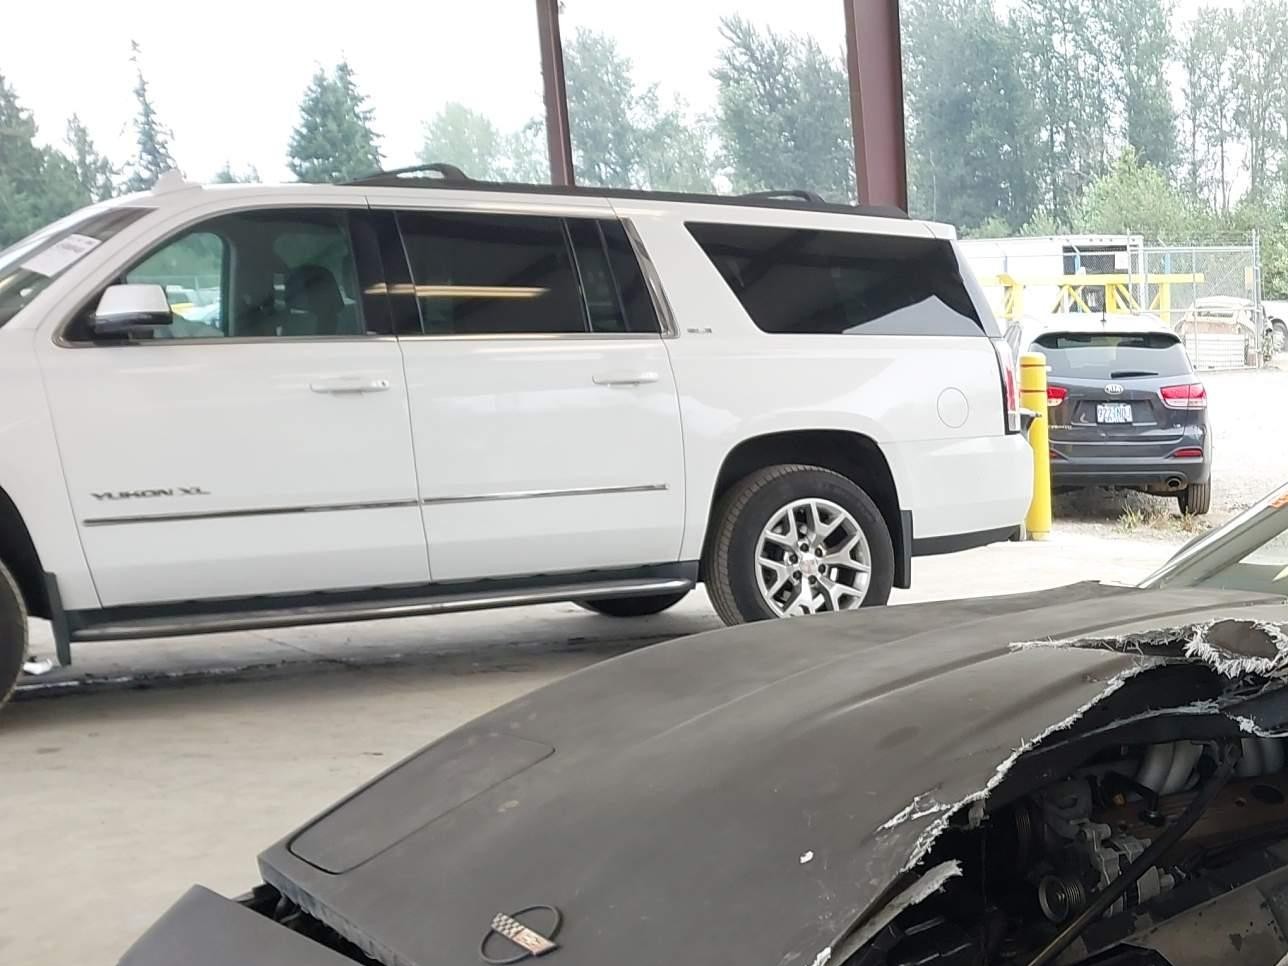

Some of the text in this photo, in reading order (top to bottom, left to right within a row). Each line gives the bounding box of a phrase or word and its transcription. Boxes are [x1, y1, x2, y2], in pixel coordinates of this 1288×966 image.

[1105, 385, 1123, 394] KIA
[90, 486, 211, 501] YUKON XL
